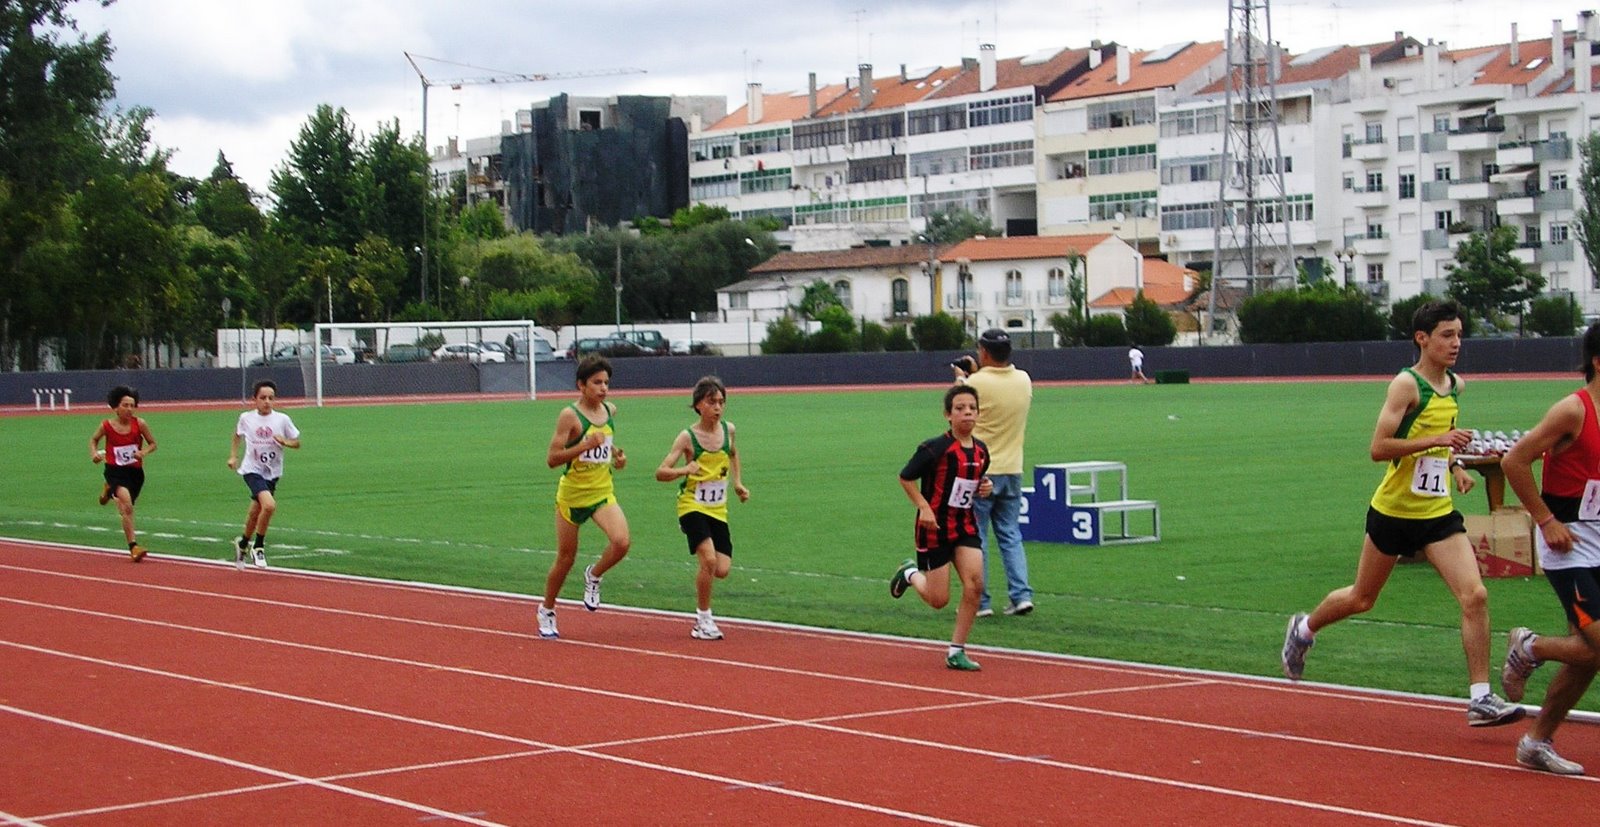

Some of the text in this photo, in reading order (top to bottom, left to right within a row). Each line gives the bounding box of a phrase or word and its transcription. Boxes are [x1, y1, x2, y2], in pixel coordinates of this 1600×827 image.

[1041, 472, 1057, 501] 1
[1417, 472, 1446, 493] 11
[959, 490, 973, 506] 5
[1072, 511, 1093, 540] 3
